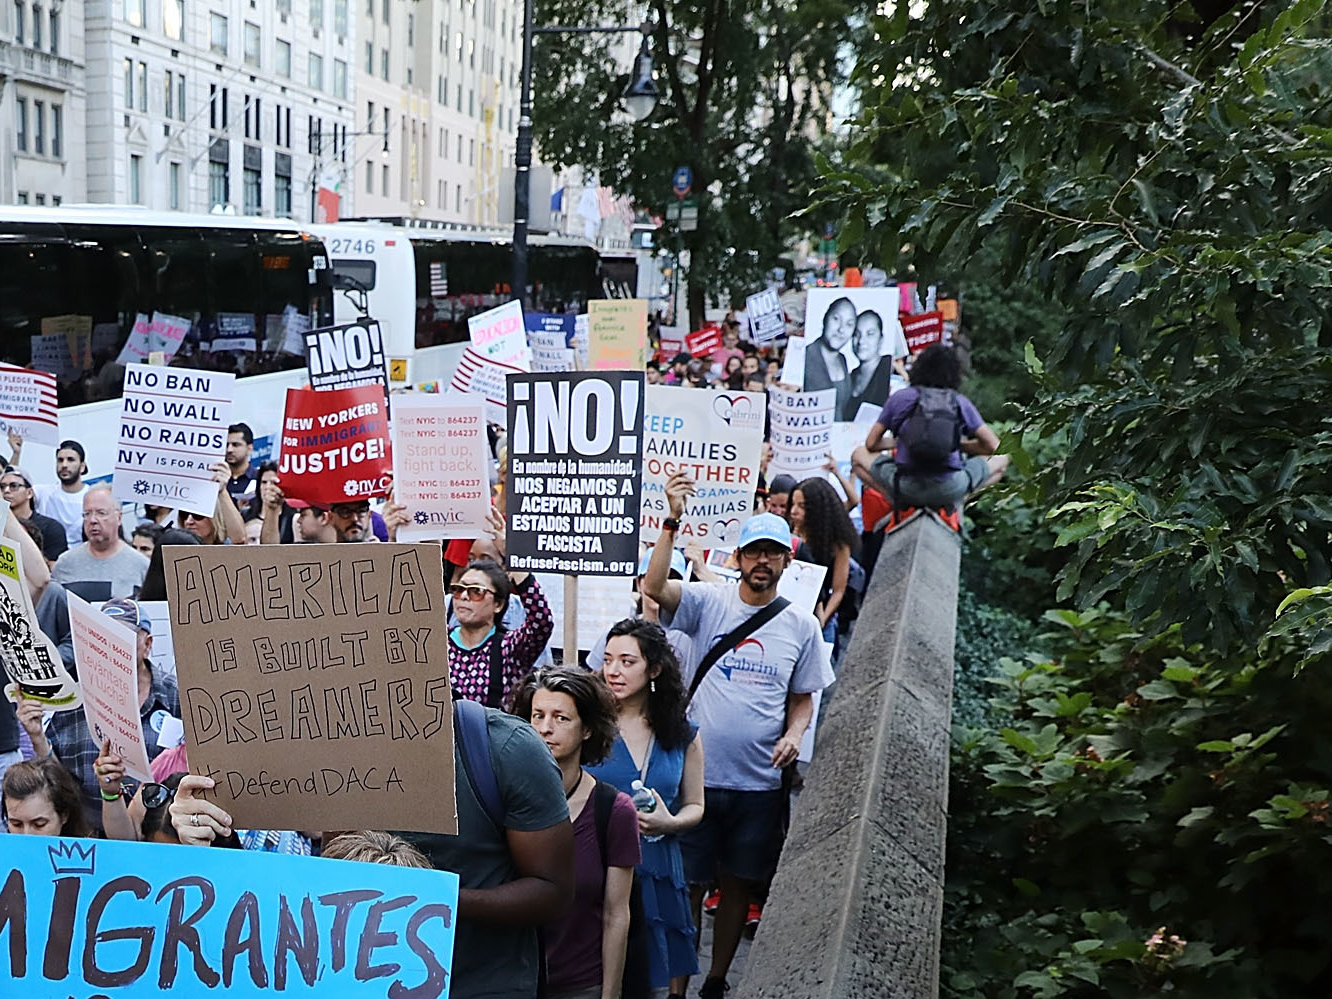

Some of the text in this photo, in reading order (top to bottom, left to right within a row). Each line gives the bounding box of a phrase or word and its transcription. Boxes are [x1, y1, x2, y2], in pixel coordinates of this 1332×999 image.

[331, 239, 375, 254] 2746
[306, 324, 383, 375] ¡NO!
[4, 385, 38, 394] PROTECT
[127, 371, 211, 393] NO BAN
[15, 404, 35, 413] YORK
[124, 398, 221, 422] NO WALL
[286, 402, 378, 430] NEW YORKERS
[513, 378, 639, 456] ¡NO!
[724, 409, 761, 420] Cabrini
[785, 414, 827, 427] WALL
[121, 424, 223, 449] NO RAIDS
[283, 421, 381, 447] FOR IMMIGRANT
[785, 432, 829, 447] RAIDS
[279, 437, 385, 474] JUSTICE!
[407, 444, 446, 457] Stand
[647, 437, 737, 461] AMILIES
[118, 450, 214, 472] NY IS FOR AL
[404, 458, 434, 474] fight
[512, 459, 525, 474] En
[525, 459, 557, 474] nombre
[567, 459, 577, 474] la
[578, 459, 636, 477] humanidad,
[514, 477, 634, 496] NOS NEGAMOS A
[520, 496, 625, 515] ACEPTAR A UN
[430, 508, 464, 526] nyic
[512, 514, 634, 534] ESTADOS UNIDOS
[537, 534, 603, 553] FASCISTA
[510, 555, 635, 575] RefuseFascism.org
[173, 549, 432, 625] AMERICA
[206, 627, 432, 674] IS BUILT BY
[723, 656, 778, 676] Cabrini
[187, 676, 446, 745] DREAMERS
[197, 764, 405, 800] #DefendDACA
